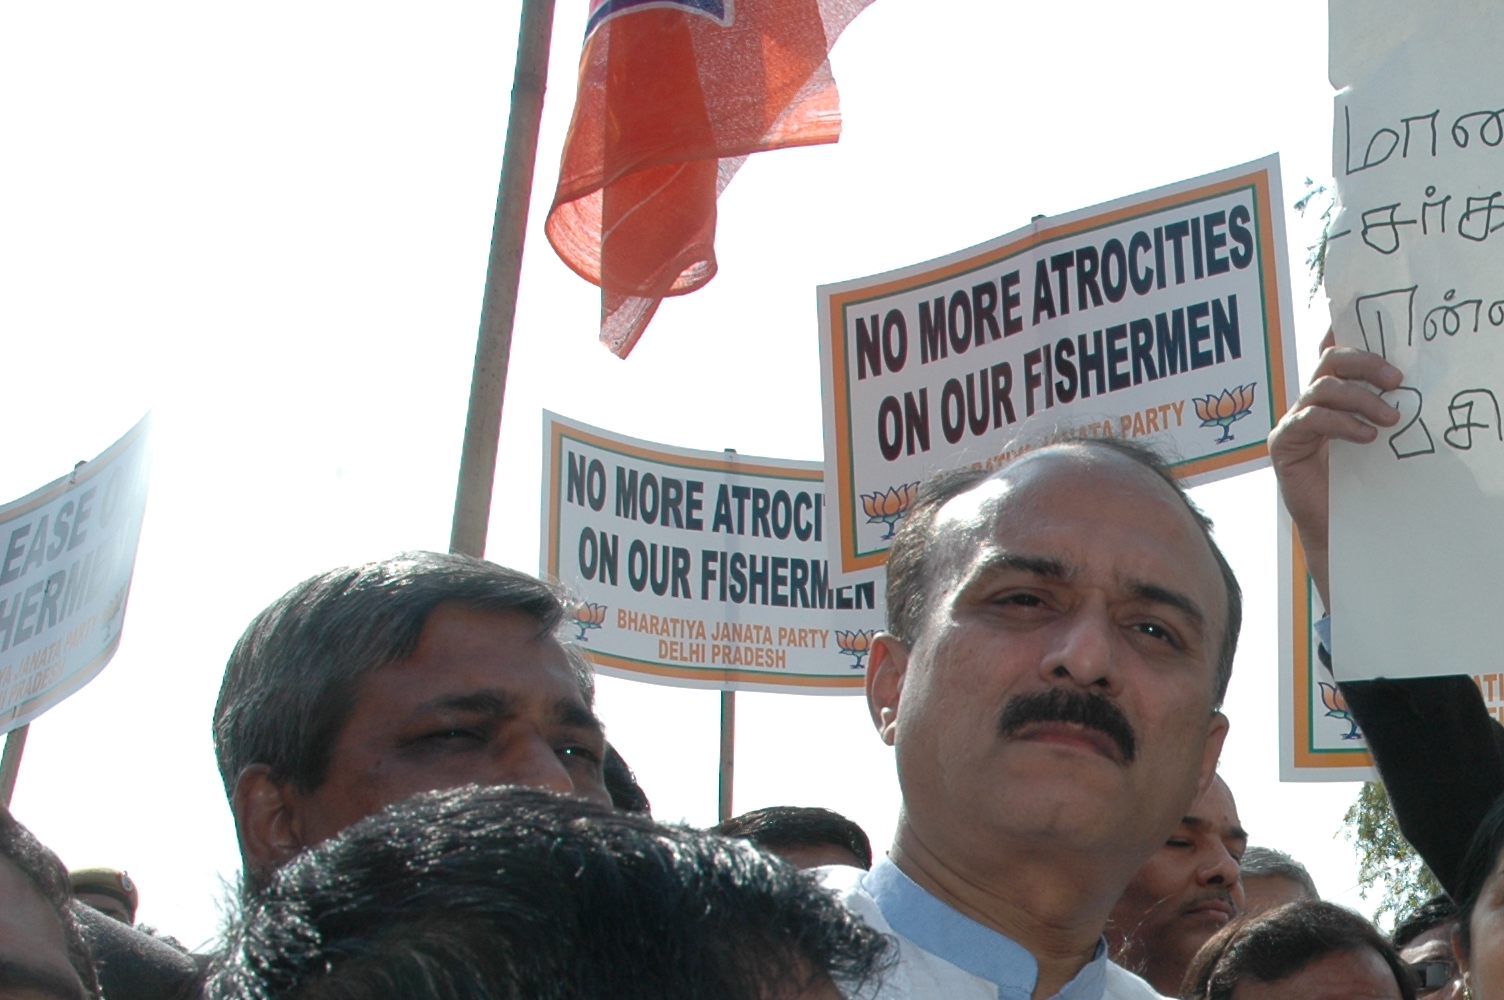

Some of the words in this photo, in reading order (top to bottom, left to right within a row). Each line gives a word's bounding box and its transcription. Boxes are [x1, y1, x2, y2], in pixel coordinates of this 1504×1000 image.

[855, 309, 908, 380] NO
[918, 270, 1024, 365] MORE
[1032, 204, 1254, 326] ATROCITIES
[878, 387, 930, 462] ON
[941, 361, 1017, 444] OUR
[1024, 294, 1242, 418] FISHERMEN
[1120, 400, 1185, 440] PARTY
[567, 451, 606, 512] NO
[615, 465, 704, 531] MORE
[712, 484, 826, 542] ATROCI
[578, 526, 619, 587] ON
[628, 539, 692, 600] OUR
[617, 608, 707, 640] BHARATIYA
[711, 621, 773, 646] JANATA
[778, 628, 830, 649] PARTY
[658, 639, 706, 663] DELHI
[711, 643, 787, 669] PRADESH
